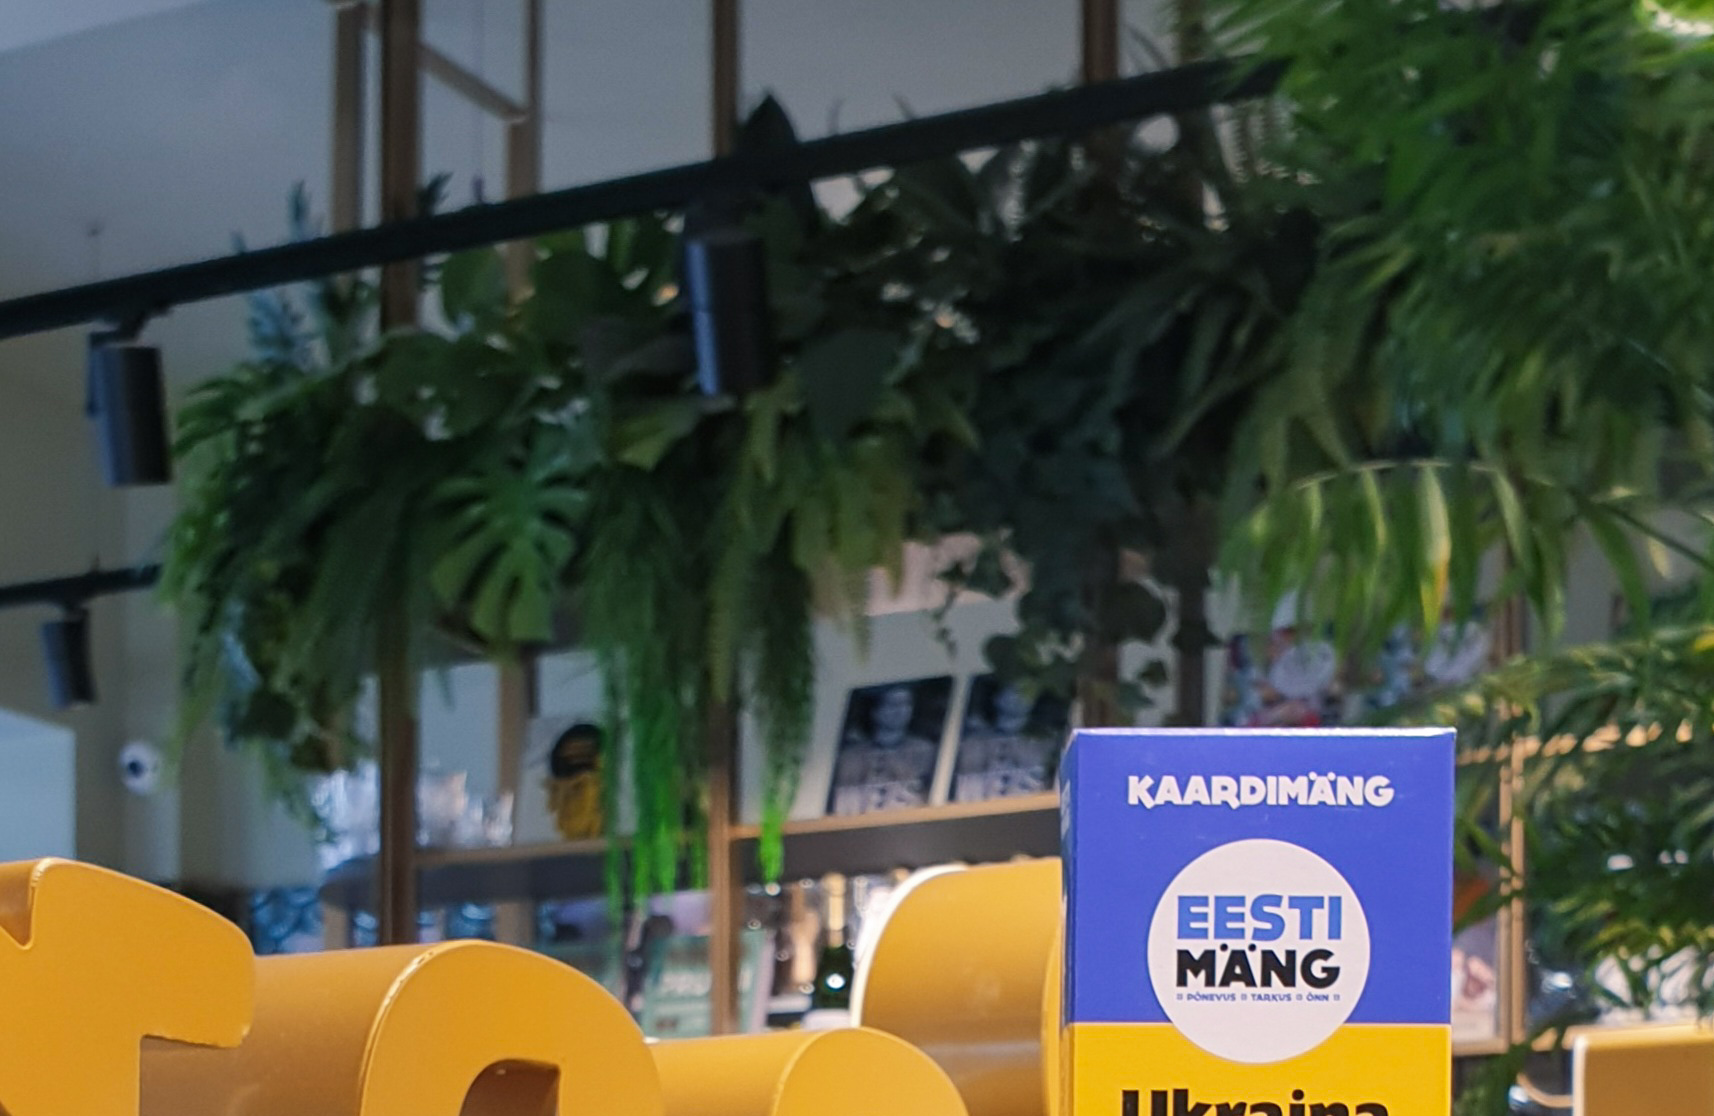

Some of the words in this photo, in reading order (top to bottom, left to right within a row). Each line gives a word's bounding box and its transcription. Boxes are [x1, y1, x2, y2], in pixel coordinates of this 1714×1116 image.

[1127, 771, 1395, 809] KAARDIMÄNG
[1176, 894, 1342, 941] EESTI
[1175, 943, 1341, 988] MÄNG
[1186, 991, 1236, 1002] PÕNEVUS
[1250, 993, 1292, 1002] TARKUS
